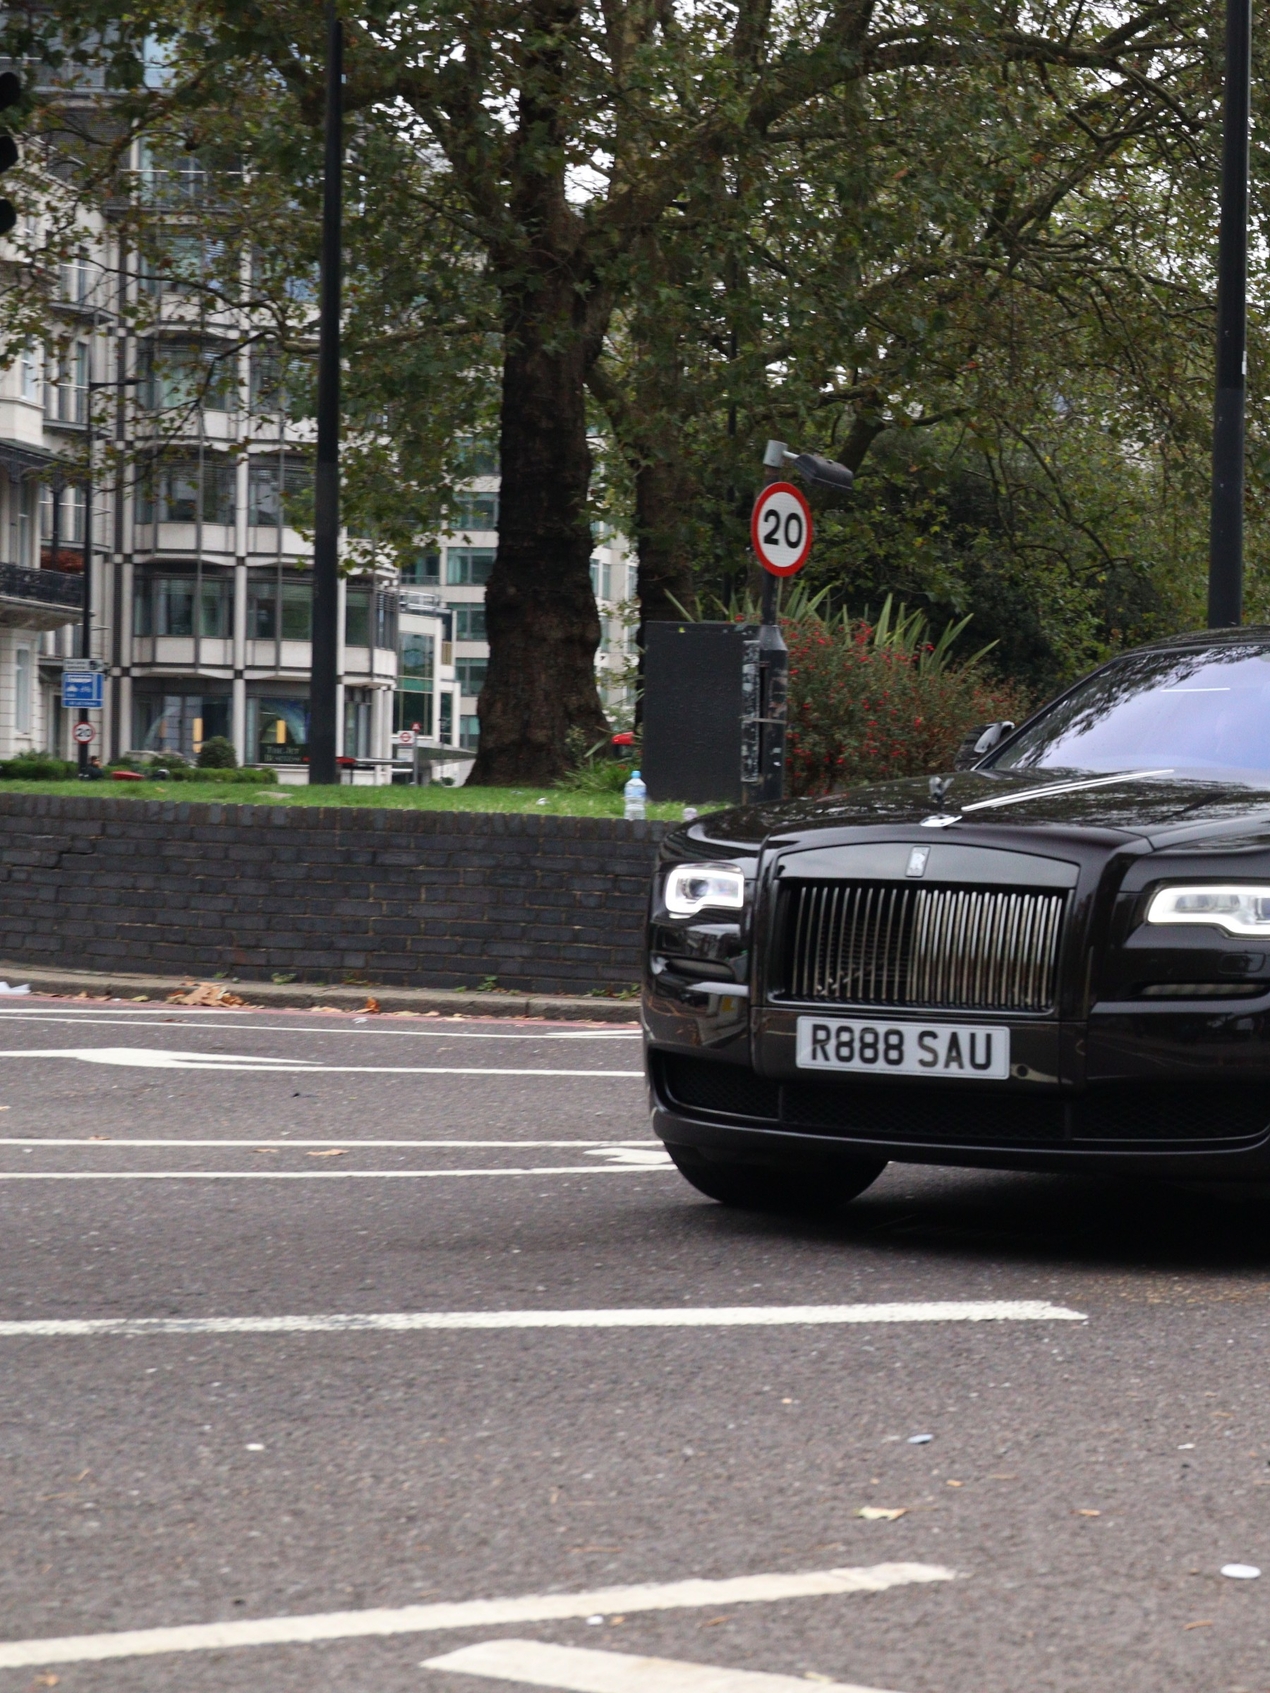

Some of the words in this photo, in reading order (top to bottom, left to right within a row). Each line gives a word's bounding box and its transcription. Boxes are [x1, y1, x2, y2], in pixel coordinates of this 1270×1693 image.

[763, 508, 803, 549] 20
[76, 727, 93, 738] 20
[811, 1023, 905, 1066] R888
[918, 1030, 993, 1071] SAU
